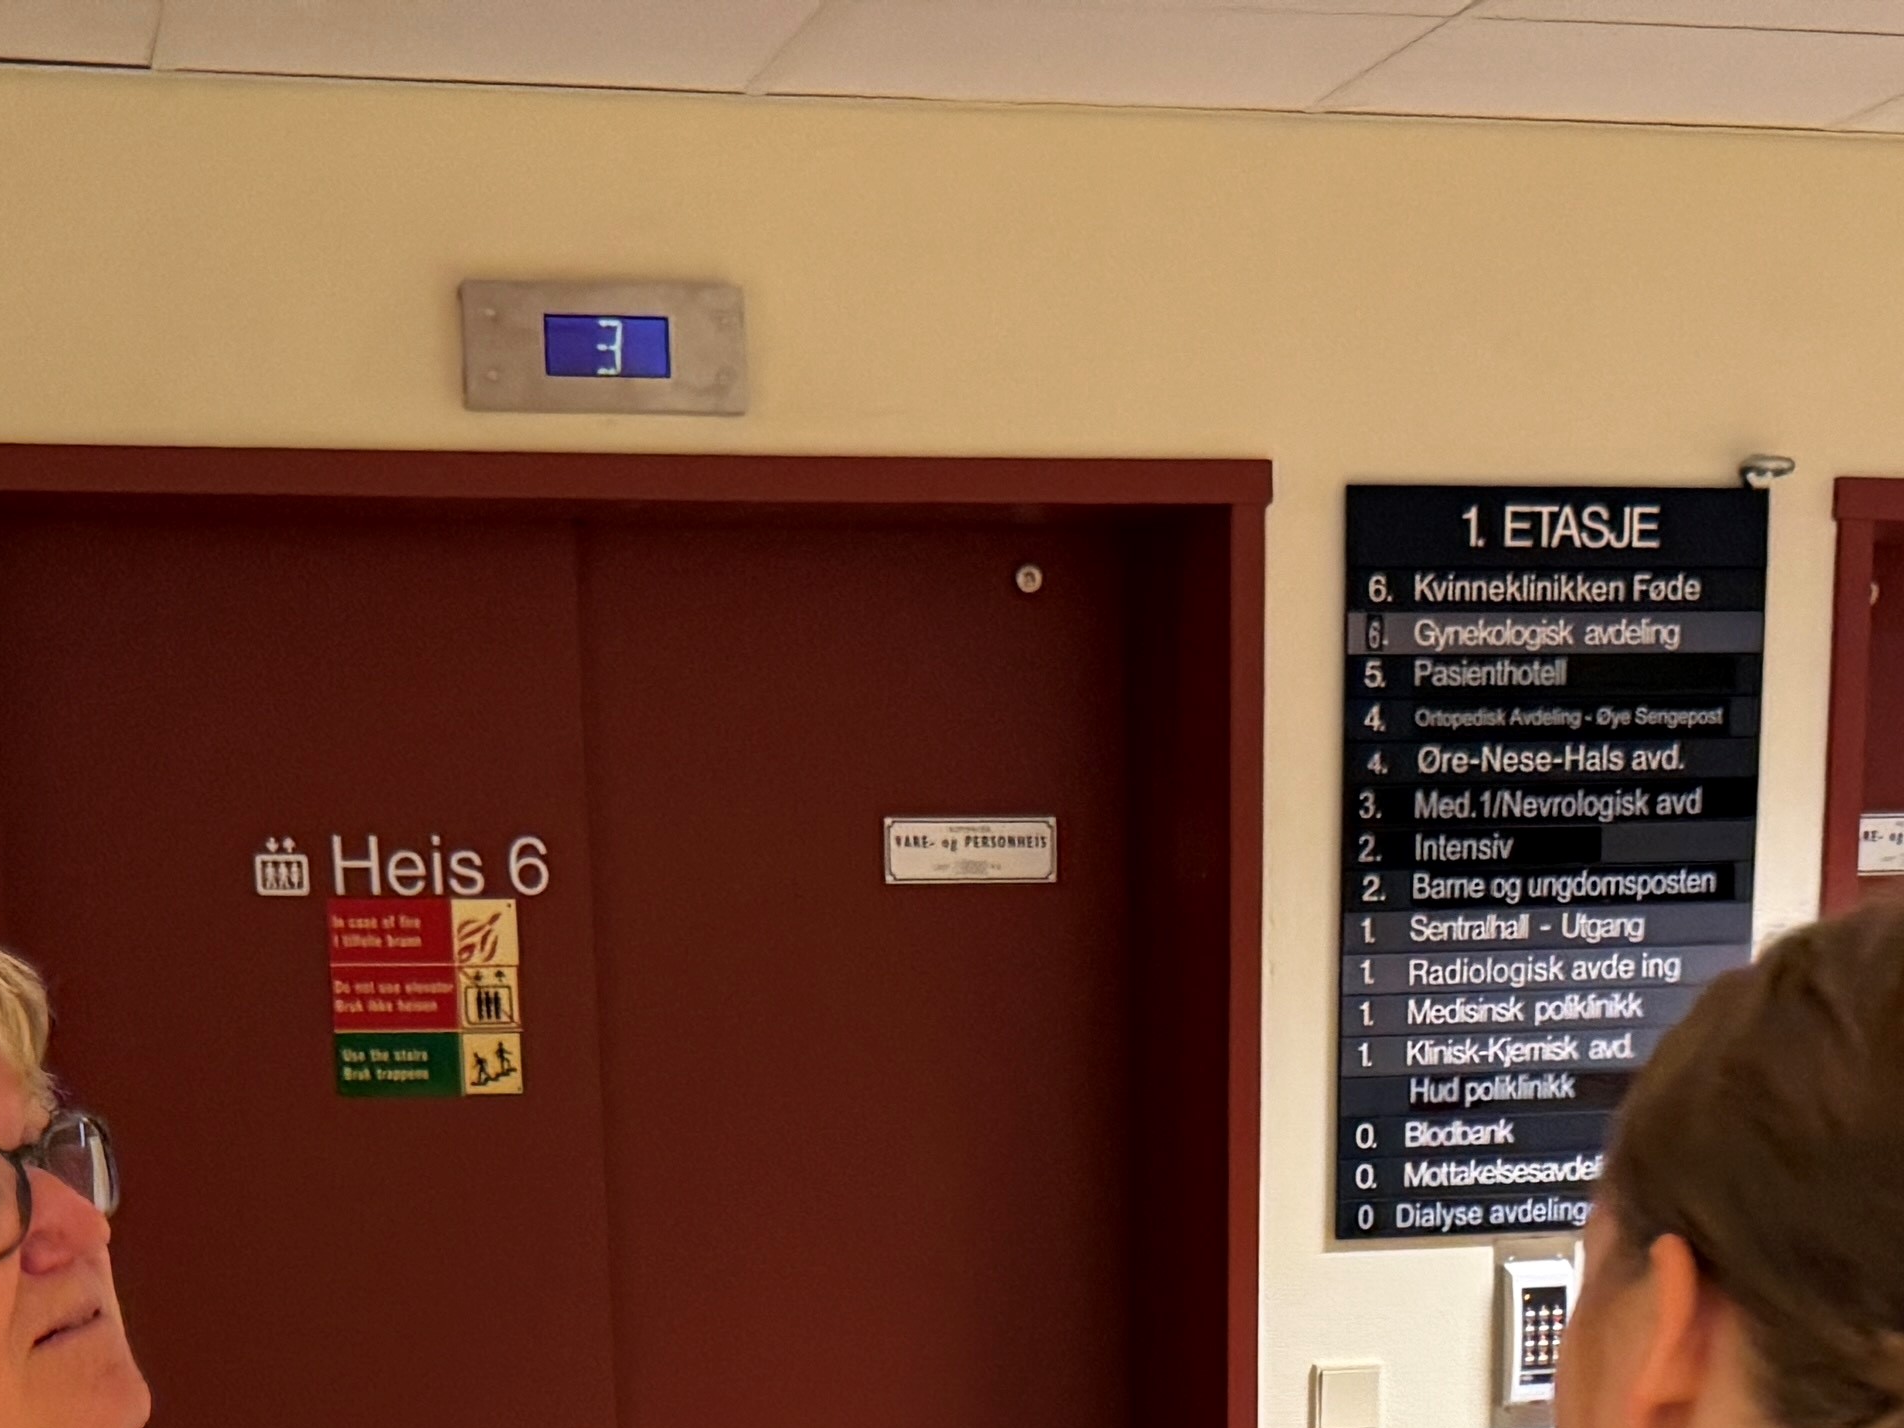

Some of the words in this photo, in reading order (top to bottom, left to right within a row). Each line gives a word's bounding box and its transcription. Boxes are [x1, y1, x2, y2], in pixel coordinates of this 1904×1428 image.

[596, 319, 623, 376] 3
[1462, 505, 1486, 547] 1.
[1504, 504, 1661, 549] ETASJE
[1368, 575, 1393, 602] 6.
[1413, 572, 1625, 602] Kvinneklinikken
[1633, 571, 1701, 601] Føde
[1413, 618, 1575, 651] Gynekologisk
[1584, 618, 1682, 650] avdeling
[1364, 660, 1387, 688] 5.
[1413, 658, 1568, 686] Pasienthotell
[1364, 704, 1386, 732] 4.
[1414, 708, 1506, 730] Ortopedisk
[1509, 707, 1582, 729] Avdeling
[1596, 706, 1633, 729] Øye
[1635, 705, 1724, 728] Sengepost
[1367, 752, 1388, 775] 4.
[1417, 743, 1626, 774] Øre-Nese-Hals
[1631, 741, 1685, 771] avd.
[1359, 791, 1382, 819] 3.
[1656, 786, 1703, 816] avd
[942, 838, 958, 852] og
[964, 835, 1048, 848] PERSONHEIS
[1358, 834, 1383, 863] 2.
[1415, 833, 1514, 862] Intensiv
[331, 834, 486, 896] Heis
[508, 836, 551, 897] 6
[1362, 874, 1386, 902] 2.
[1490, 877, 1522, 904] og
[1527, 869, 1717, 903] ungdomsposten
[1360, 917, 1376, 944] 1.
[1409, 913, 1530, 942] Sentralhall
[1561, 912, 1646, 943] Utgang
[1408, 955, 1565, 987] Radiologisk
[1407, 996, 1526, 1025] Medisinsk
[1534, 993, 1645, 1026] poliklinikk
[342, 1048, 366, 1063] Use
[369, 1048, 389, 1062] the
[393, 1049, 429, 1062] stairs
[1406, 1035, 1580, 1068] Klinisk-Kjemisk
[1588, 1032, 1636, 1060] avd.
[1409, 1077, 1460, 1104] Hud
[1464, 1072, 1577, 1108] poliklinikk
[1355, 1122, 1378, 1149] 0.
[1404, 1118, 1516, 1148] Blodbank
[1355, 1163, 1378, 1190] 0.
[1358, 1204, 1375, 1230] 0
[1395, 1200, 1484, 1232] Dialyse
[1489, 1196, 1587, 1227] avdeling
